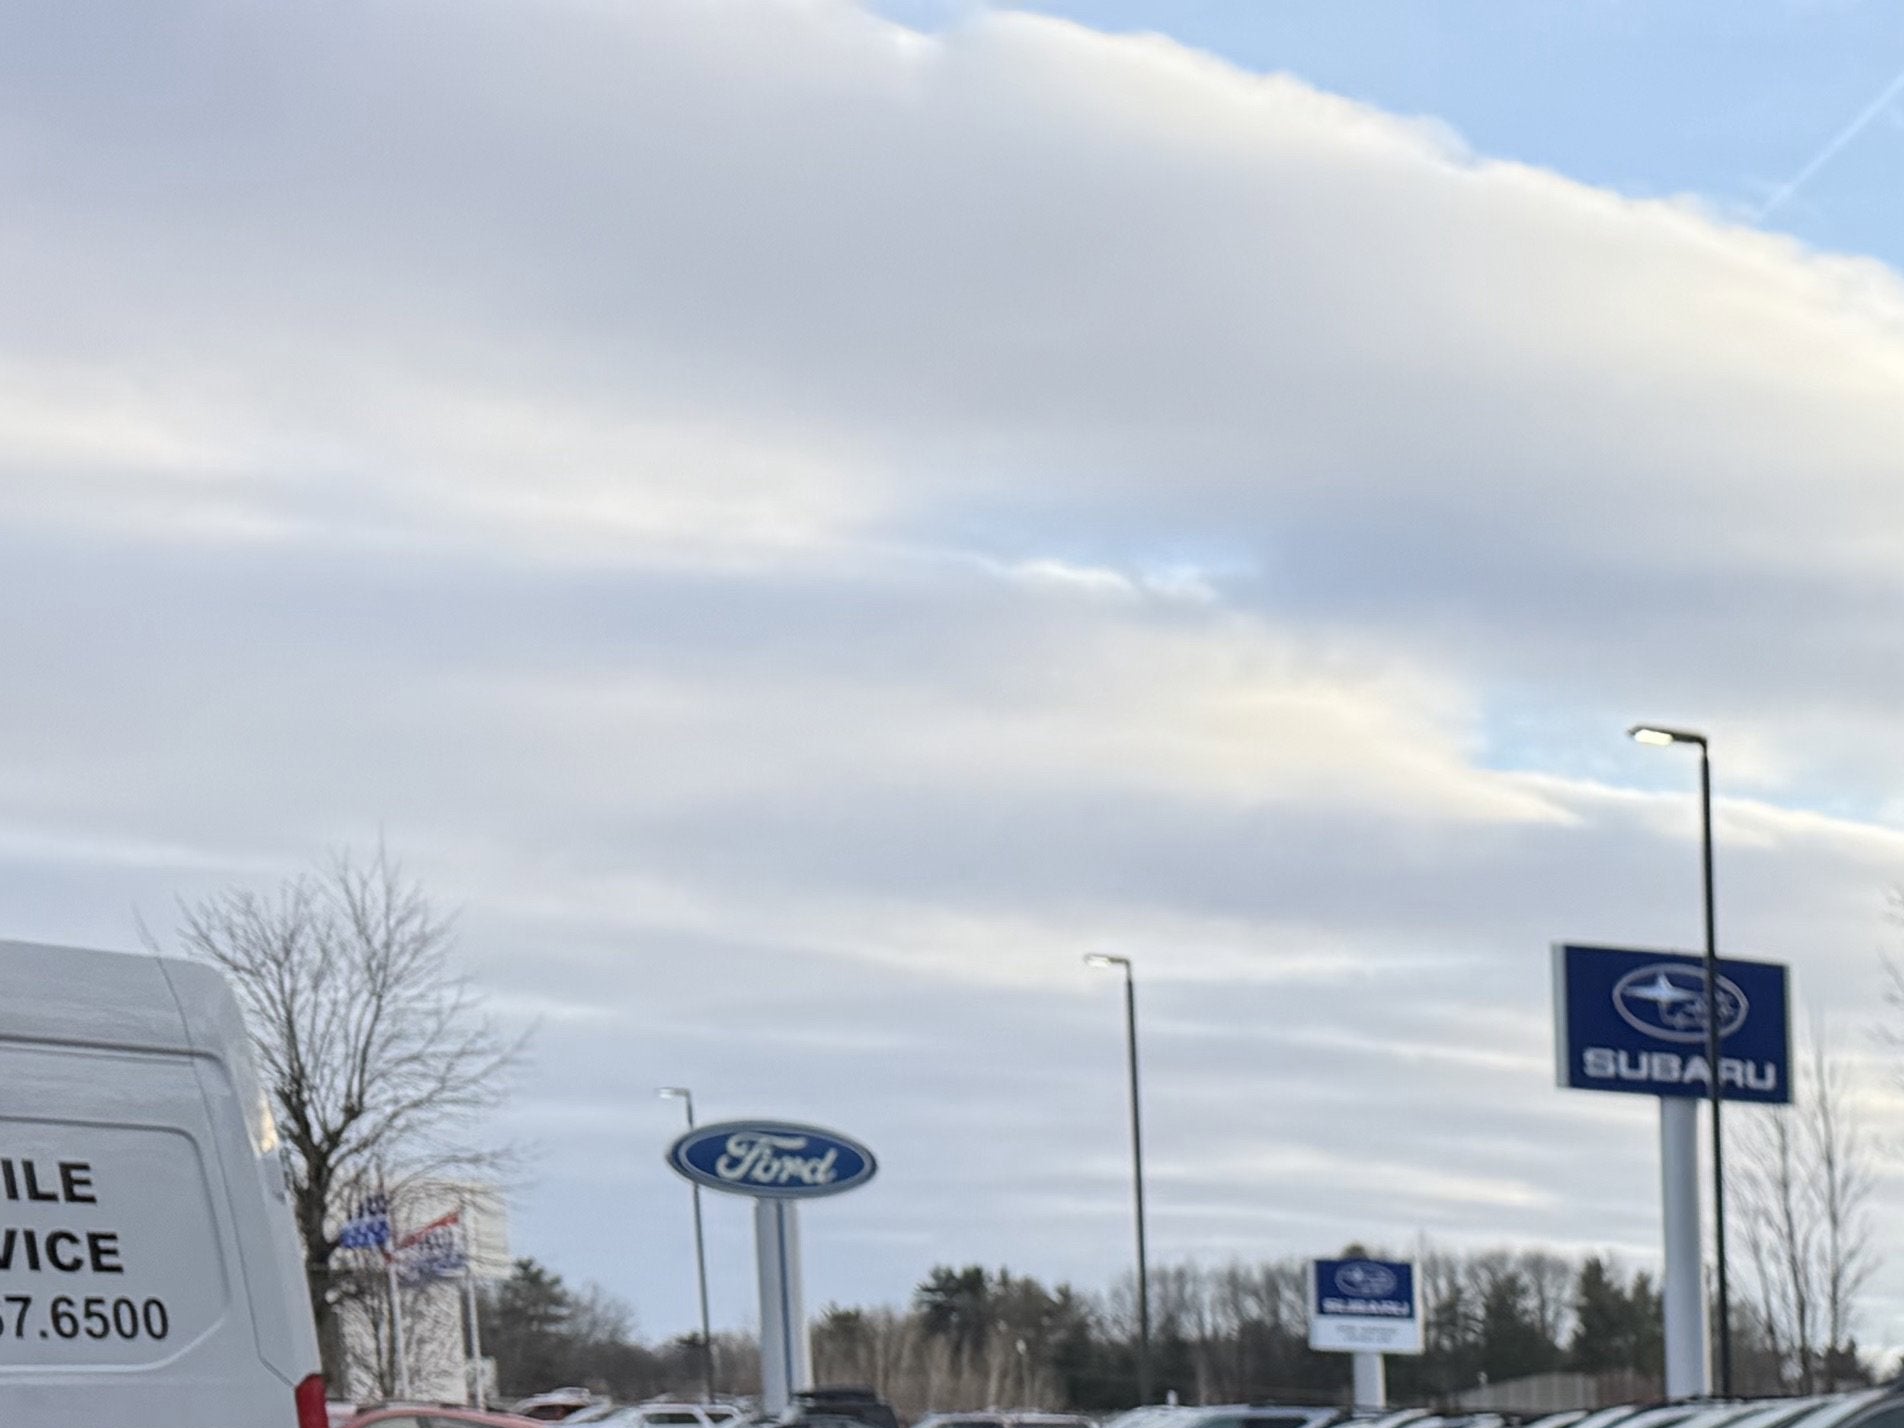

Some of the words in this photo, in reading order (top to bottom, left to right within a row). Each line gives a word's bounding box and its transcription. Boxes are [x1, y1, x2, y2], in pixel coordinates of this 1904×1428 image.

[1582, 1046, 1778, 1092] SUBARU
[0, 1157, 98, 1204] ILE
[715, 1131, 838, 1184] Ford
[0, 1294, 169, 1341] 7.6500
